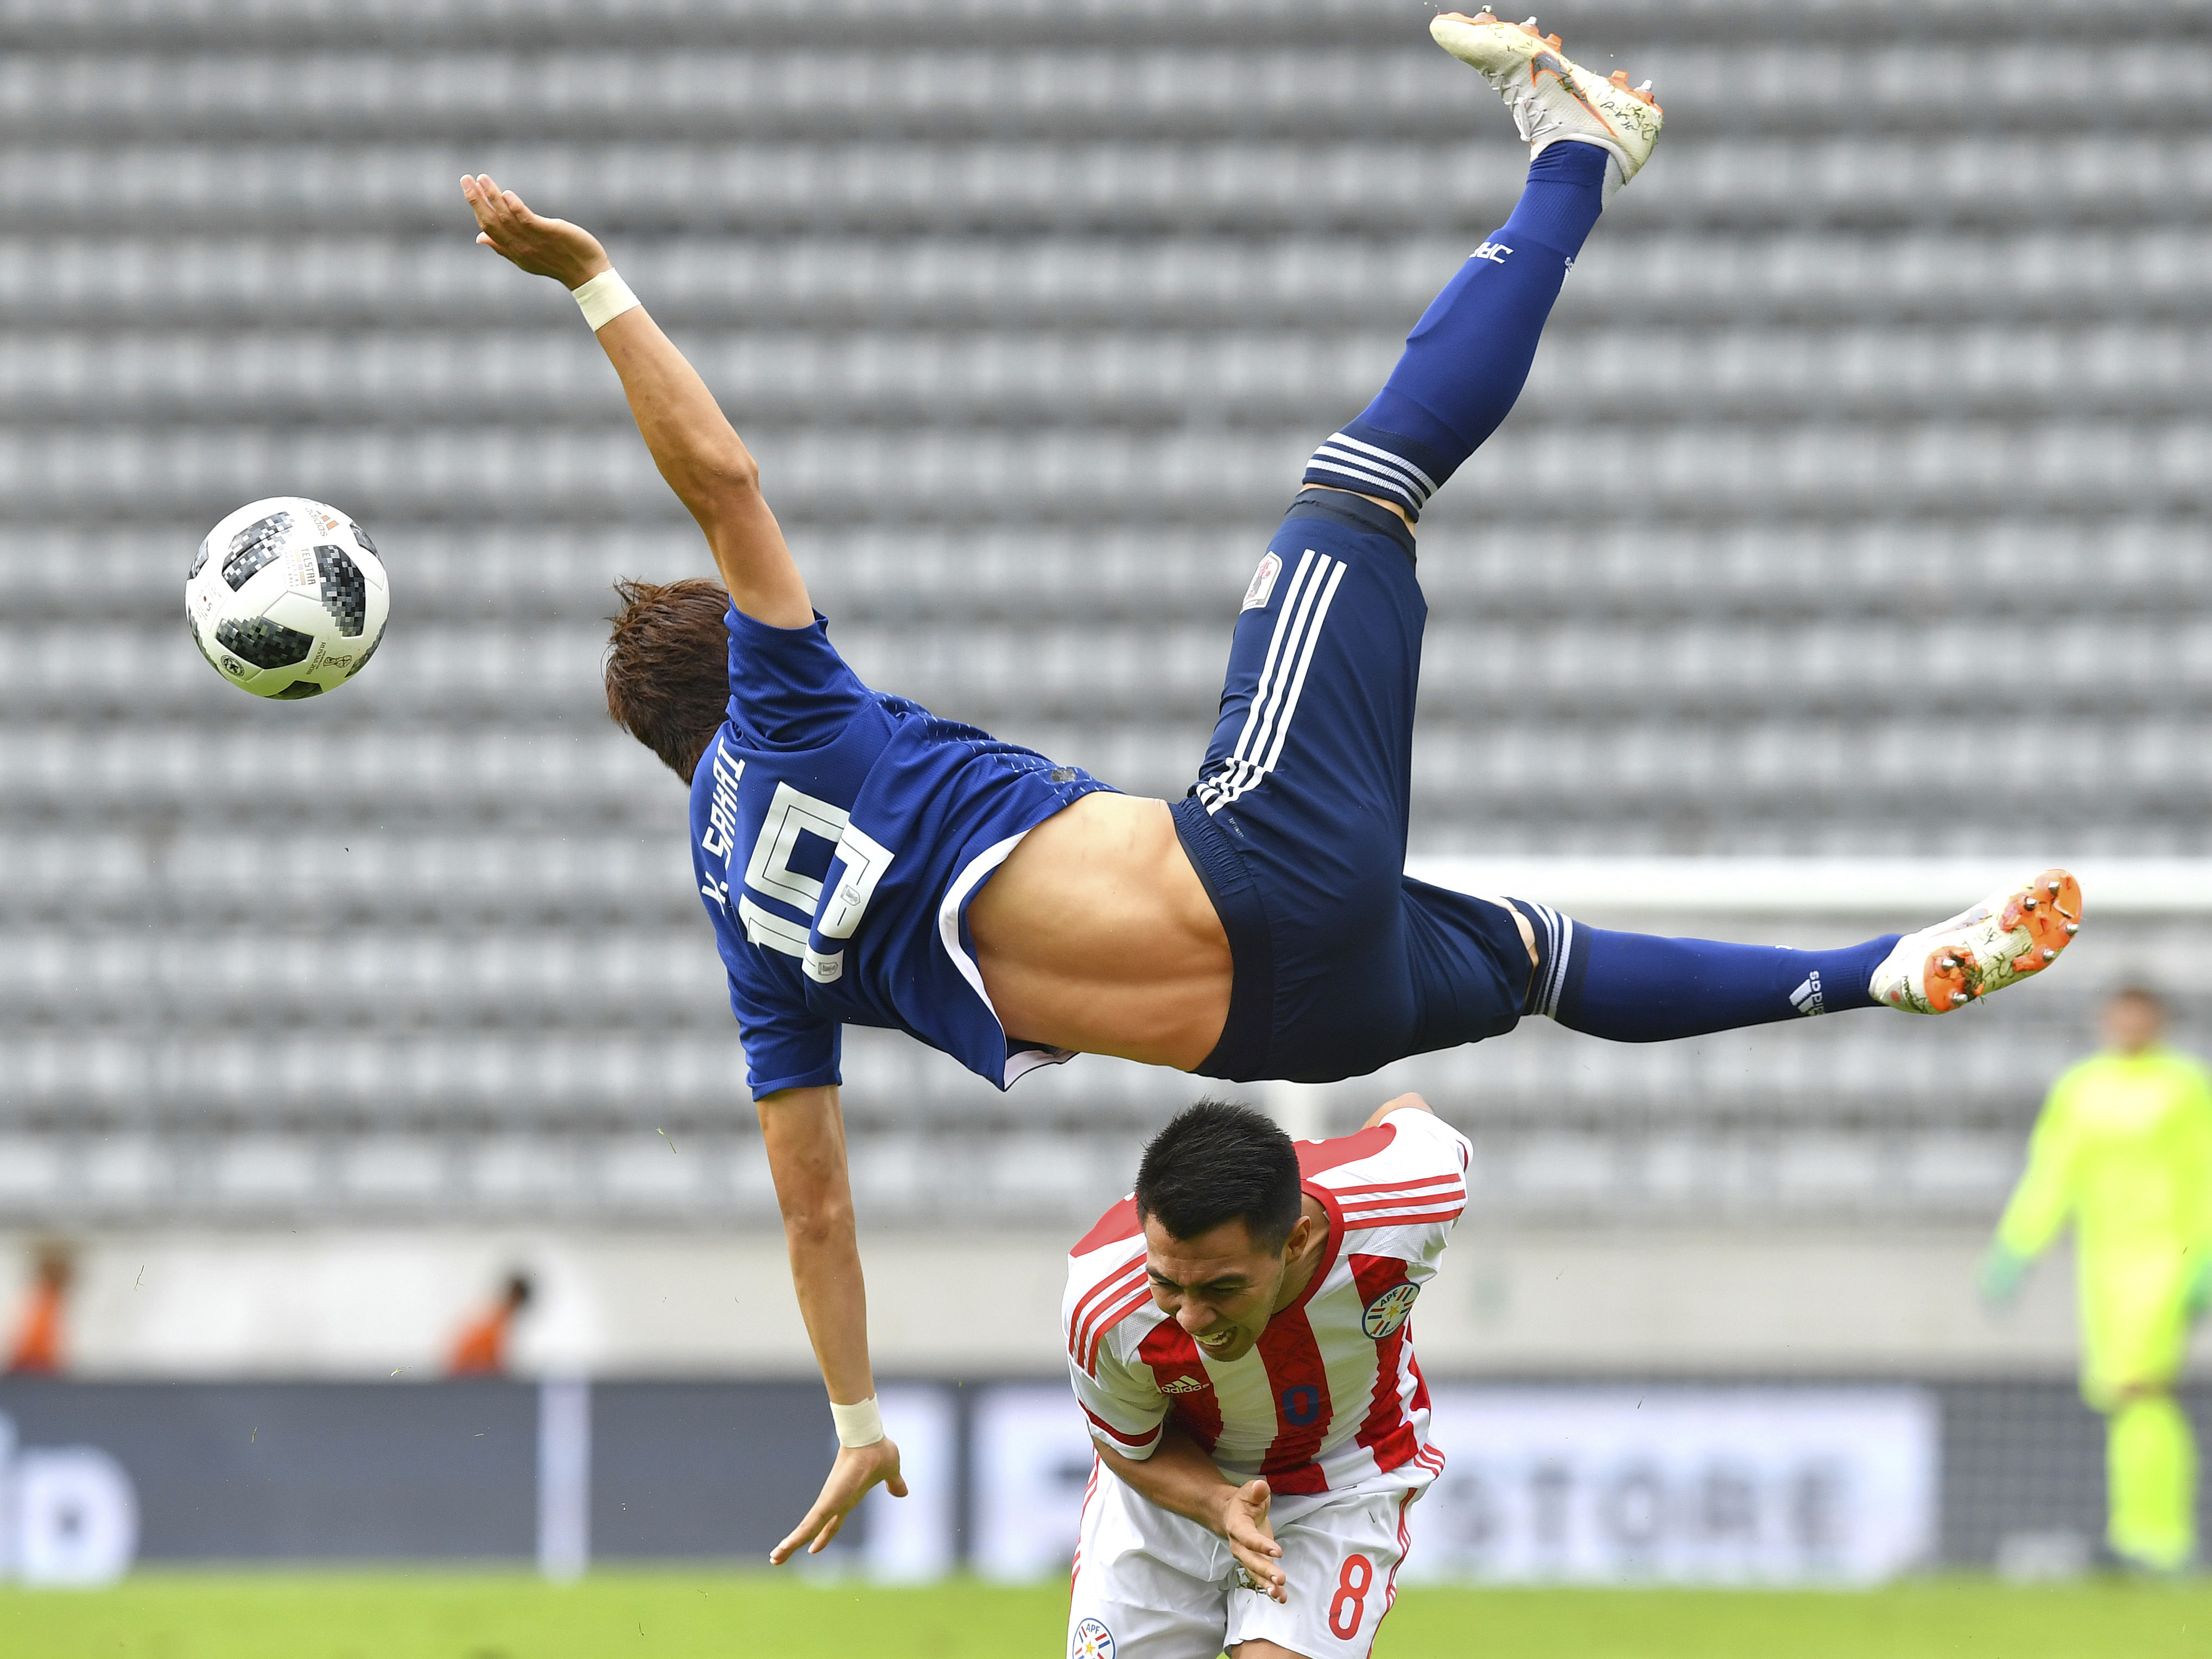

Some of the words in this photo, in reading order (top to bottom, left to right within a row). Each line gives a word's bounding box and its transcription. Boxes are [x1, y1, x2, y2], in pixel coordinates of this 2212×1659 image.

[305, 508, 328, 536] adidas
[314, 642, 326, 663] RUSSIA
[702, 736, 746, 871] SAKAI
[1380, 1289, 1398, 1308] APF
[1161, 1383, 1210, 1394] adidas
[1328, 1554, 1373, 1641] 8
[1086, 1623, 1100, 1634] APF
